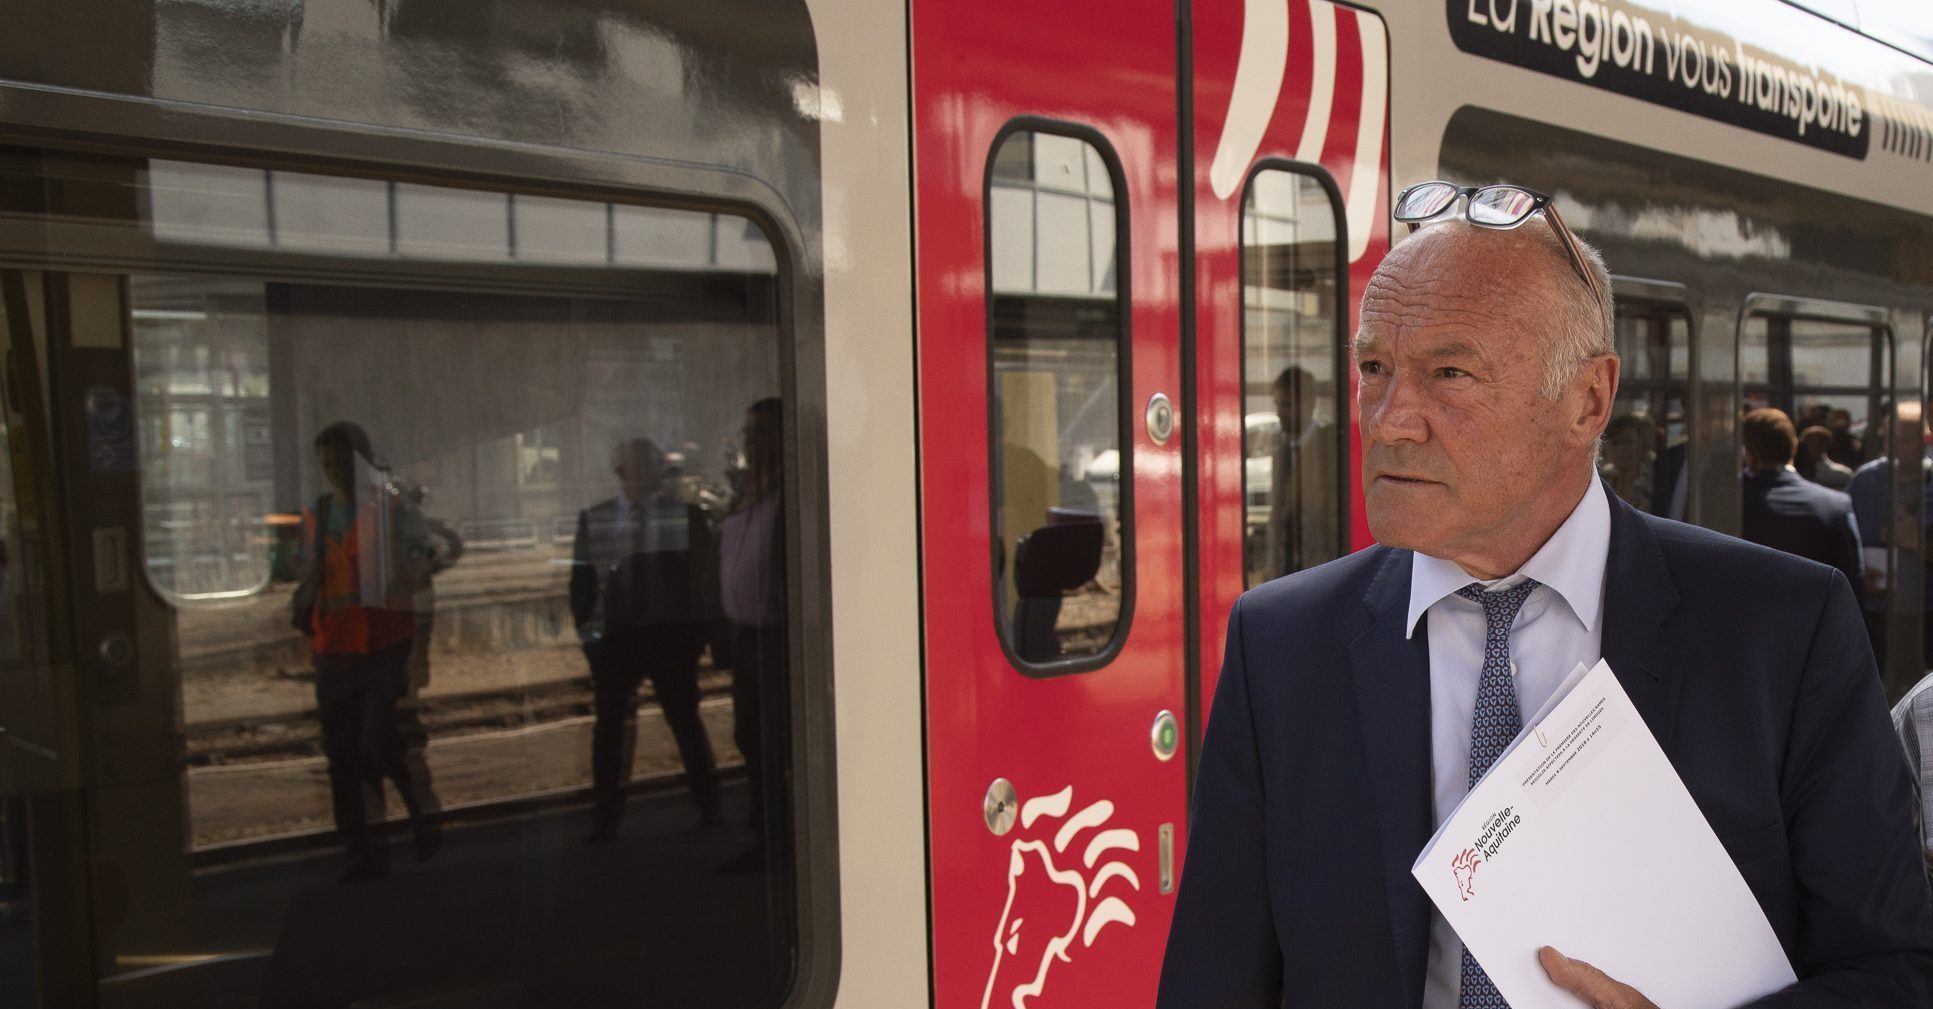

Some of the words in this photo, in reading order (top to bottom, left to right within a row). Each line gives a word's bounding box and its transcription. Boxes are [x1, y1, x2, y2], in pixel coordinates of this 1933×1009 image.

[1660, 26, 1732, 98] vous
[1734, 39, 1863, 137] transporte
[1474, 805, 1514, 852] Nouvelle-
[1483, 814, 1520, 862] Aquitaine
